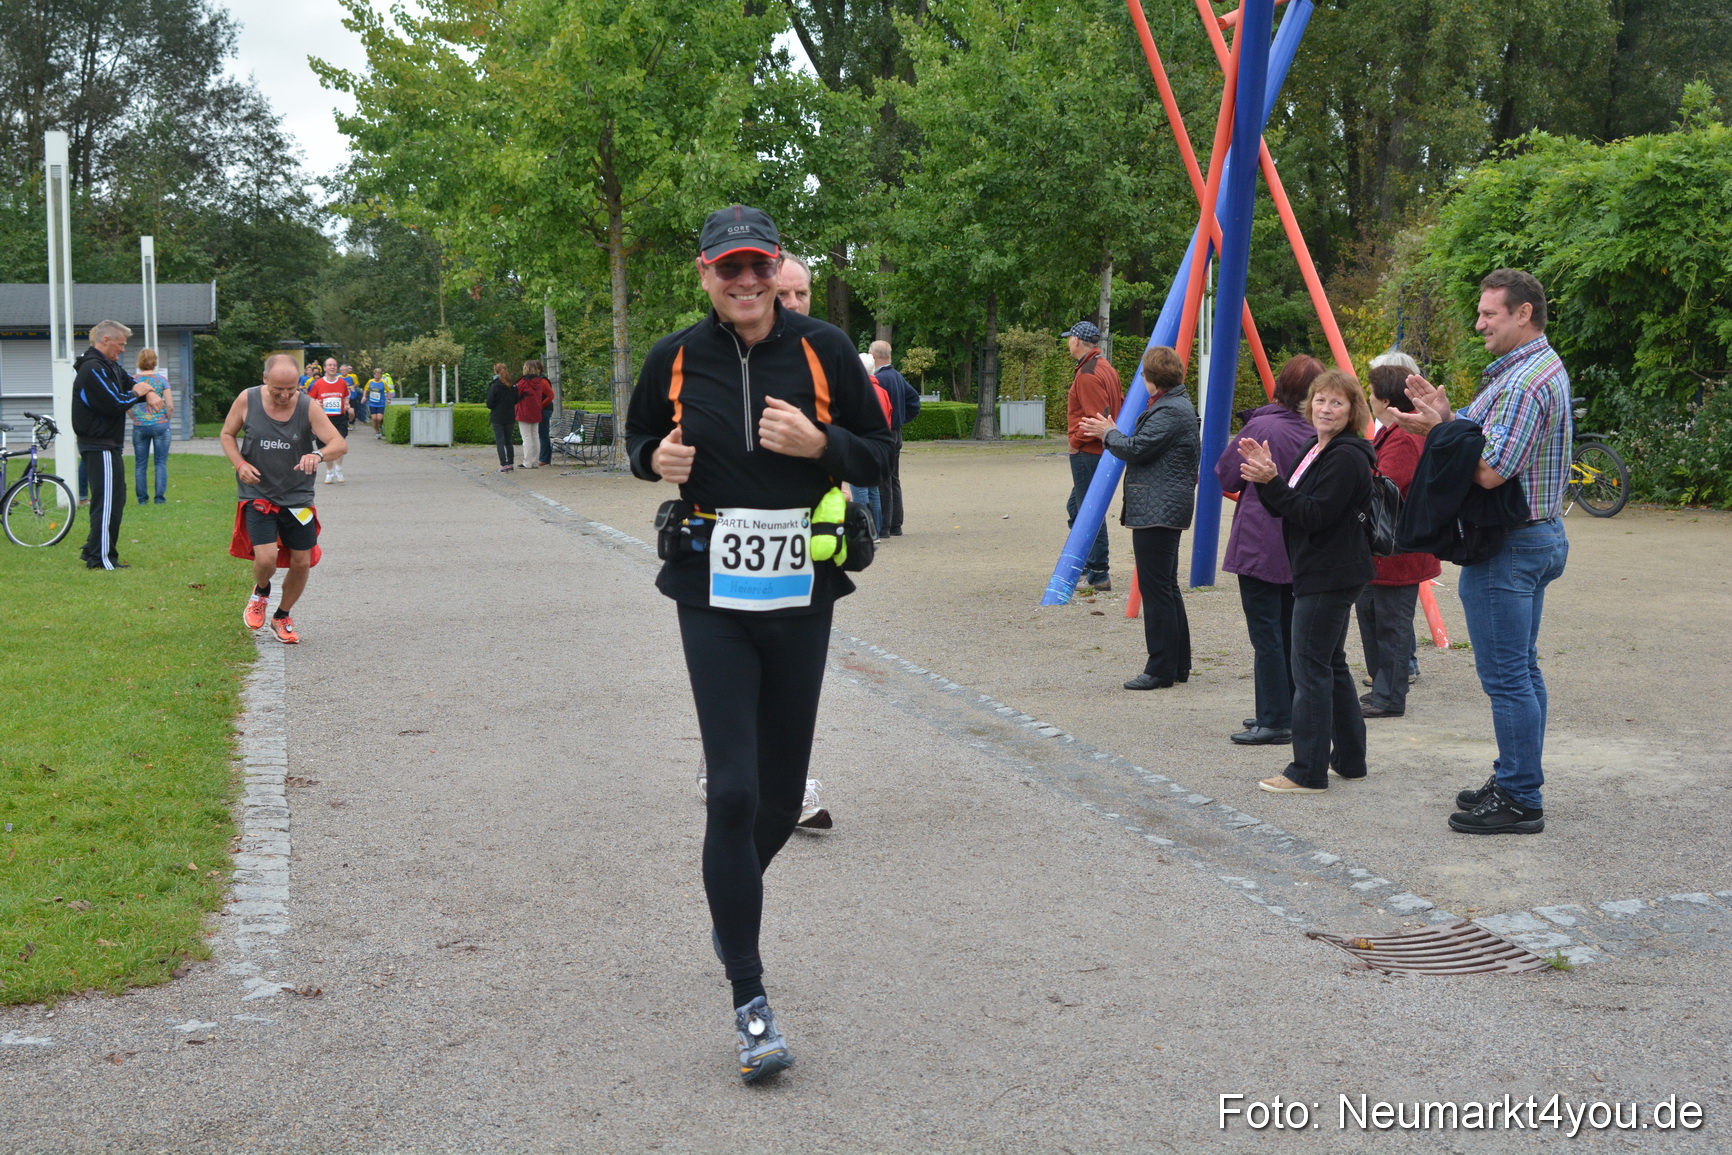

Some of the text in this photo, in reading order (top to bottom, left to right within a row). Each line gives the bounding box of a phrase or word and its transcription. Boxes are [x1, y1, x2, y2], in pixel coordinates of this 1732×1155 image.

[728, 225, 750, 233] GORE
[716, 518, 798, 530] PARTL Neumarkt
[722, 533, 806, 571] 3379
[730, 580, 774, 595] Heinrich
